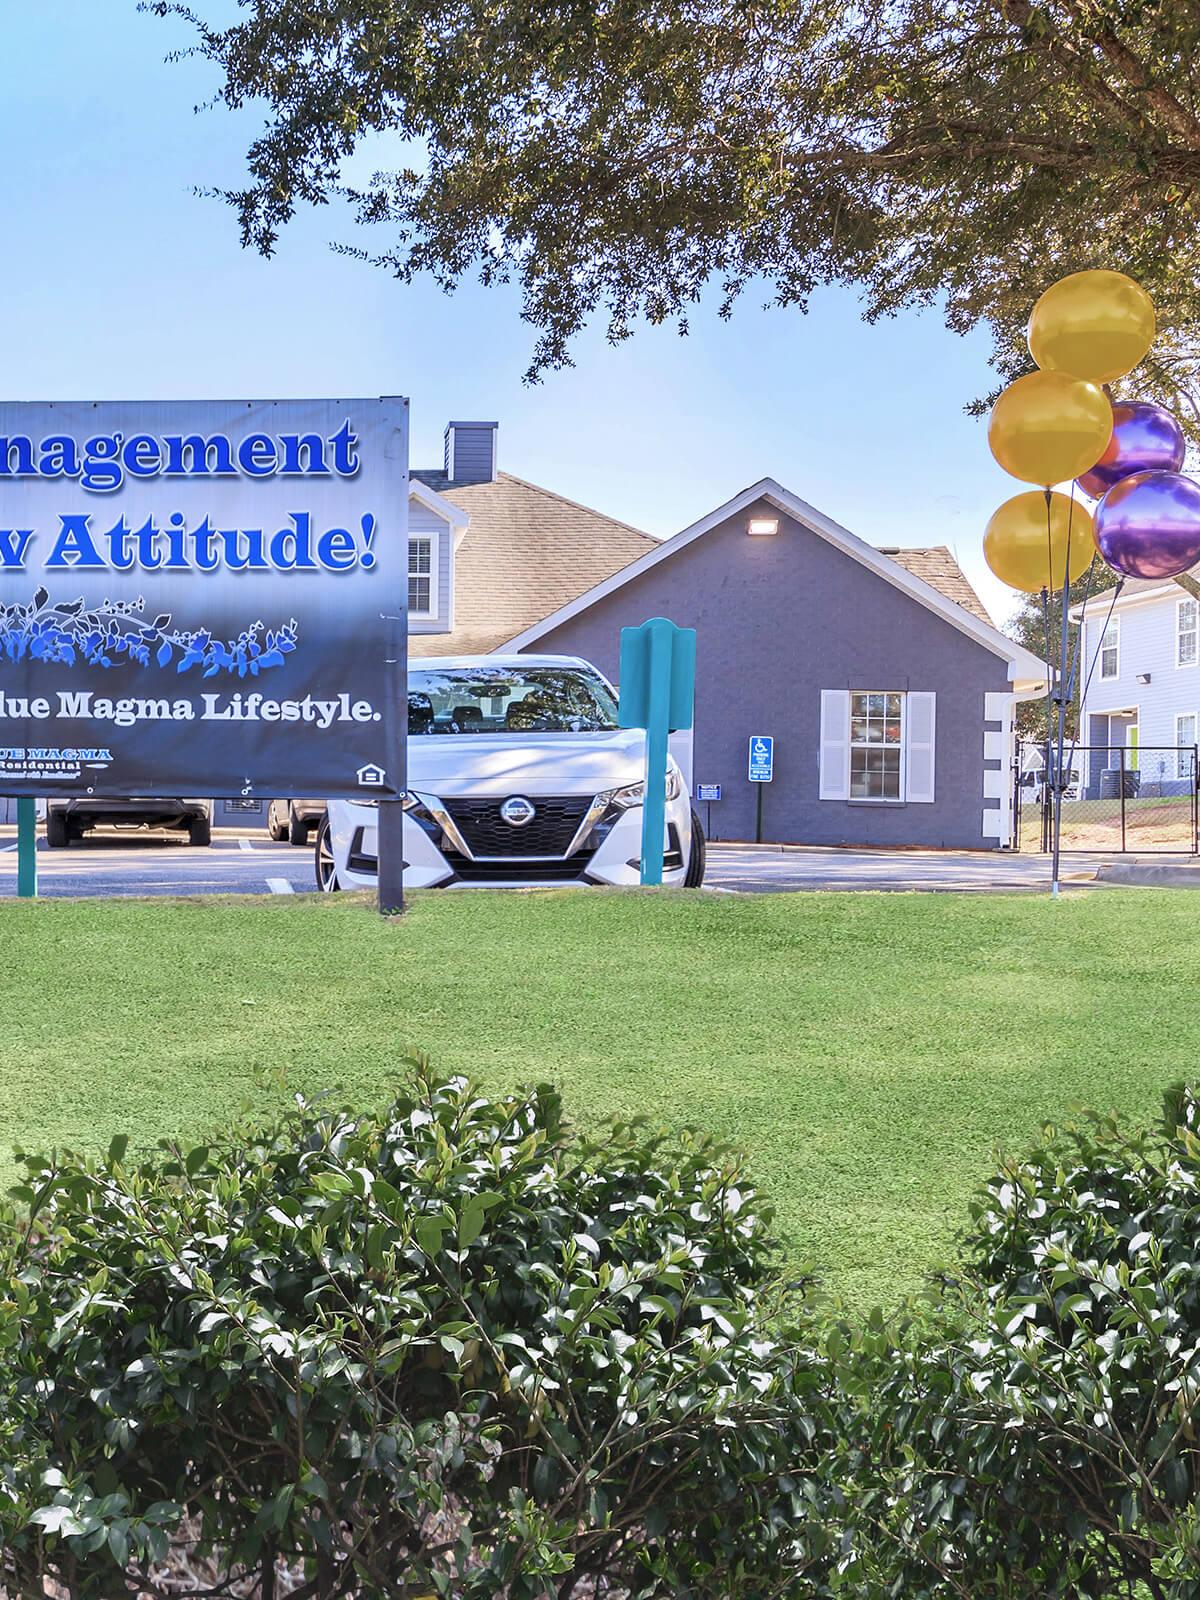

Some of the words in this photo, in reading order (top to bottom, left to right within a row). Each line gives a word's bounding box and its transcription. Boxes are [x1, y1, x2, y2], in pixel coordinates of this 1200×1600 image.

[43, 511, 377, 571] Attitude!
[56, 691, 195, 726] Magma
[201, 692, 381, 728] Lifestyle.
[27, 748, 114, 761] MAGMA
